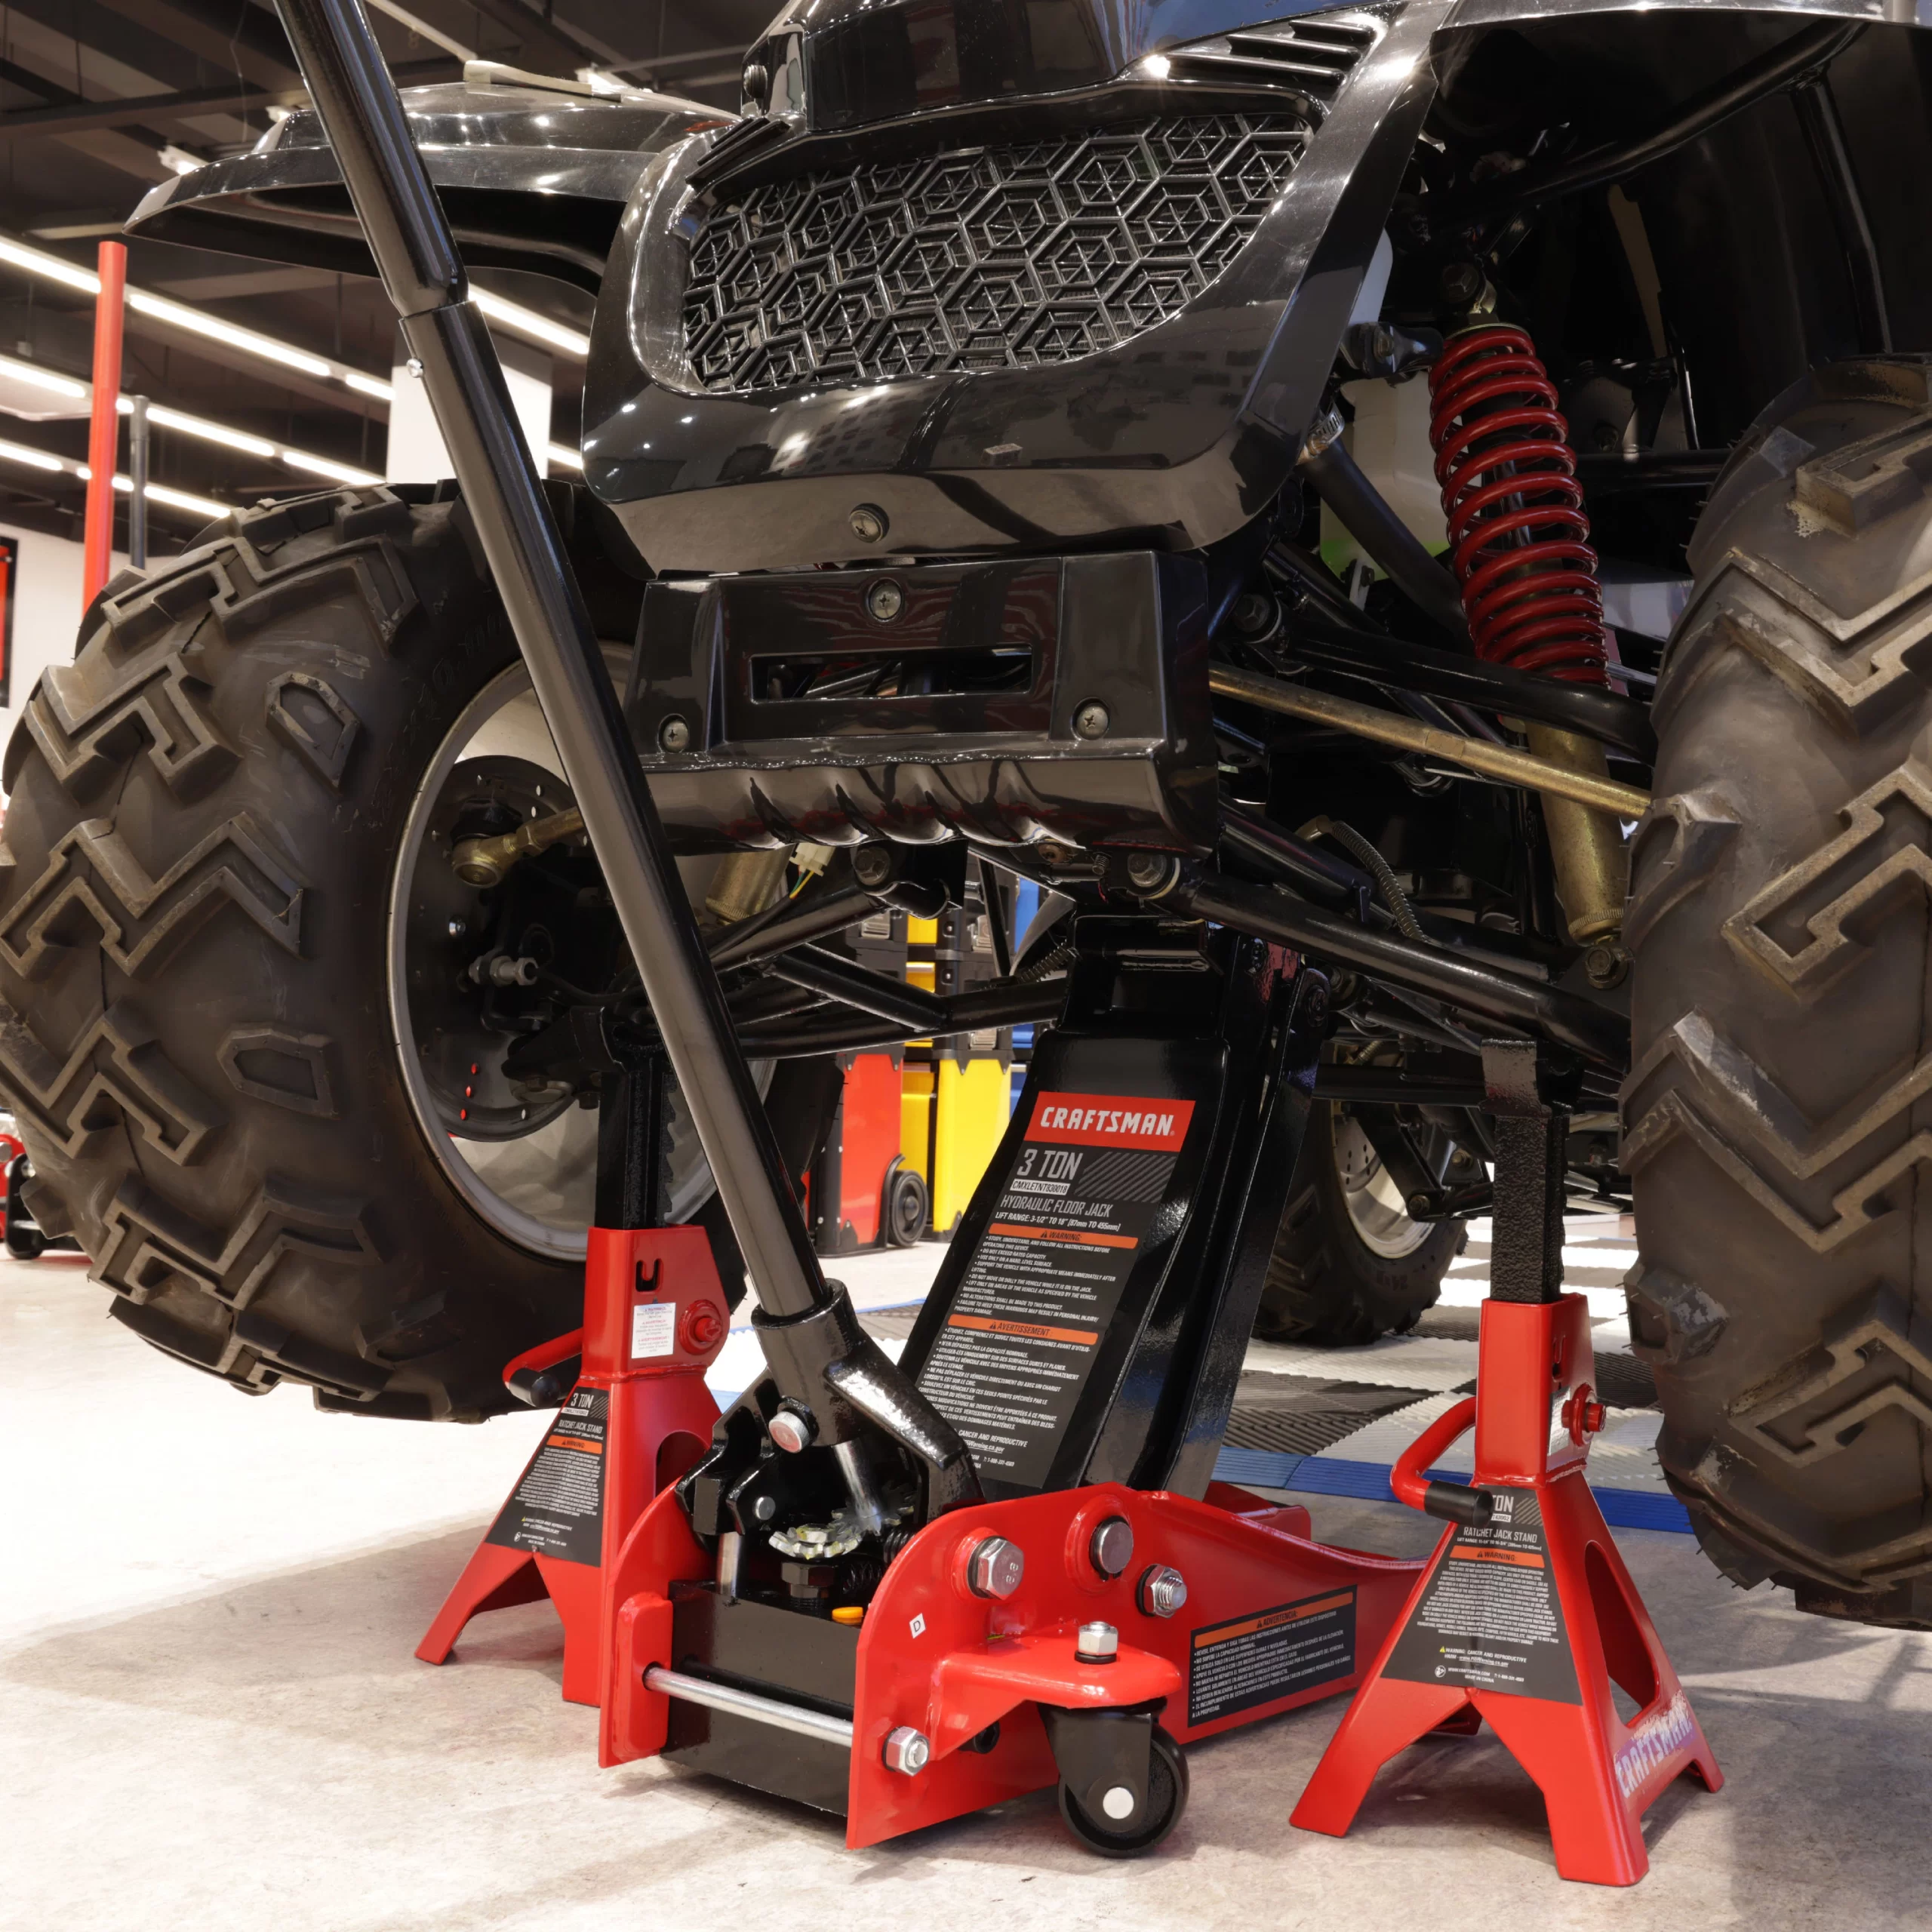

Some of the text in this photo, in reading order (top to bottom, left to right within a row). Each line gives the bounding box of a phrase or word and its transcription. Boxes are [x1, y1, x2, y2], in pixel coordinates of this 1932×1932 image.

[1040, 1106, 1174, 1137] CRAFTSMAN
[1016, 1148, 1084, 1180] 3 TON
[999, 1194, 1113, 1217] HYDRAULIC FLOOR JACK
[994, 1211, 1008, 1220] LIFT
[1007, 1213, 1031, 1222] RANGE:
[1048, 1217, 1058, 1225] TO
[1087, 1220, 1097, 1229] TO
[1048, 1231, 1082, 1241] WARNING:
[571, 1393, 594, 1408] 3 TON
[586, 1424, 603, 1434] STAND
[958, 1429, 978, 1438] CANCER
[990, 1435, 1028, 1447] REPRODUCTIVE
[1463, 1526, 1537, 1543] RATCHET JACK STAND
[913, 1620, 921, 1632] D
[1494, 1653, 1527, 1663] REPRODUCTIVE
[1615, 1704, 1693, 1798] CRAFTSMAN
